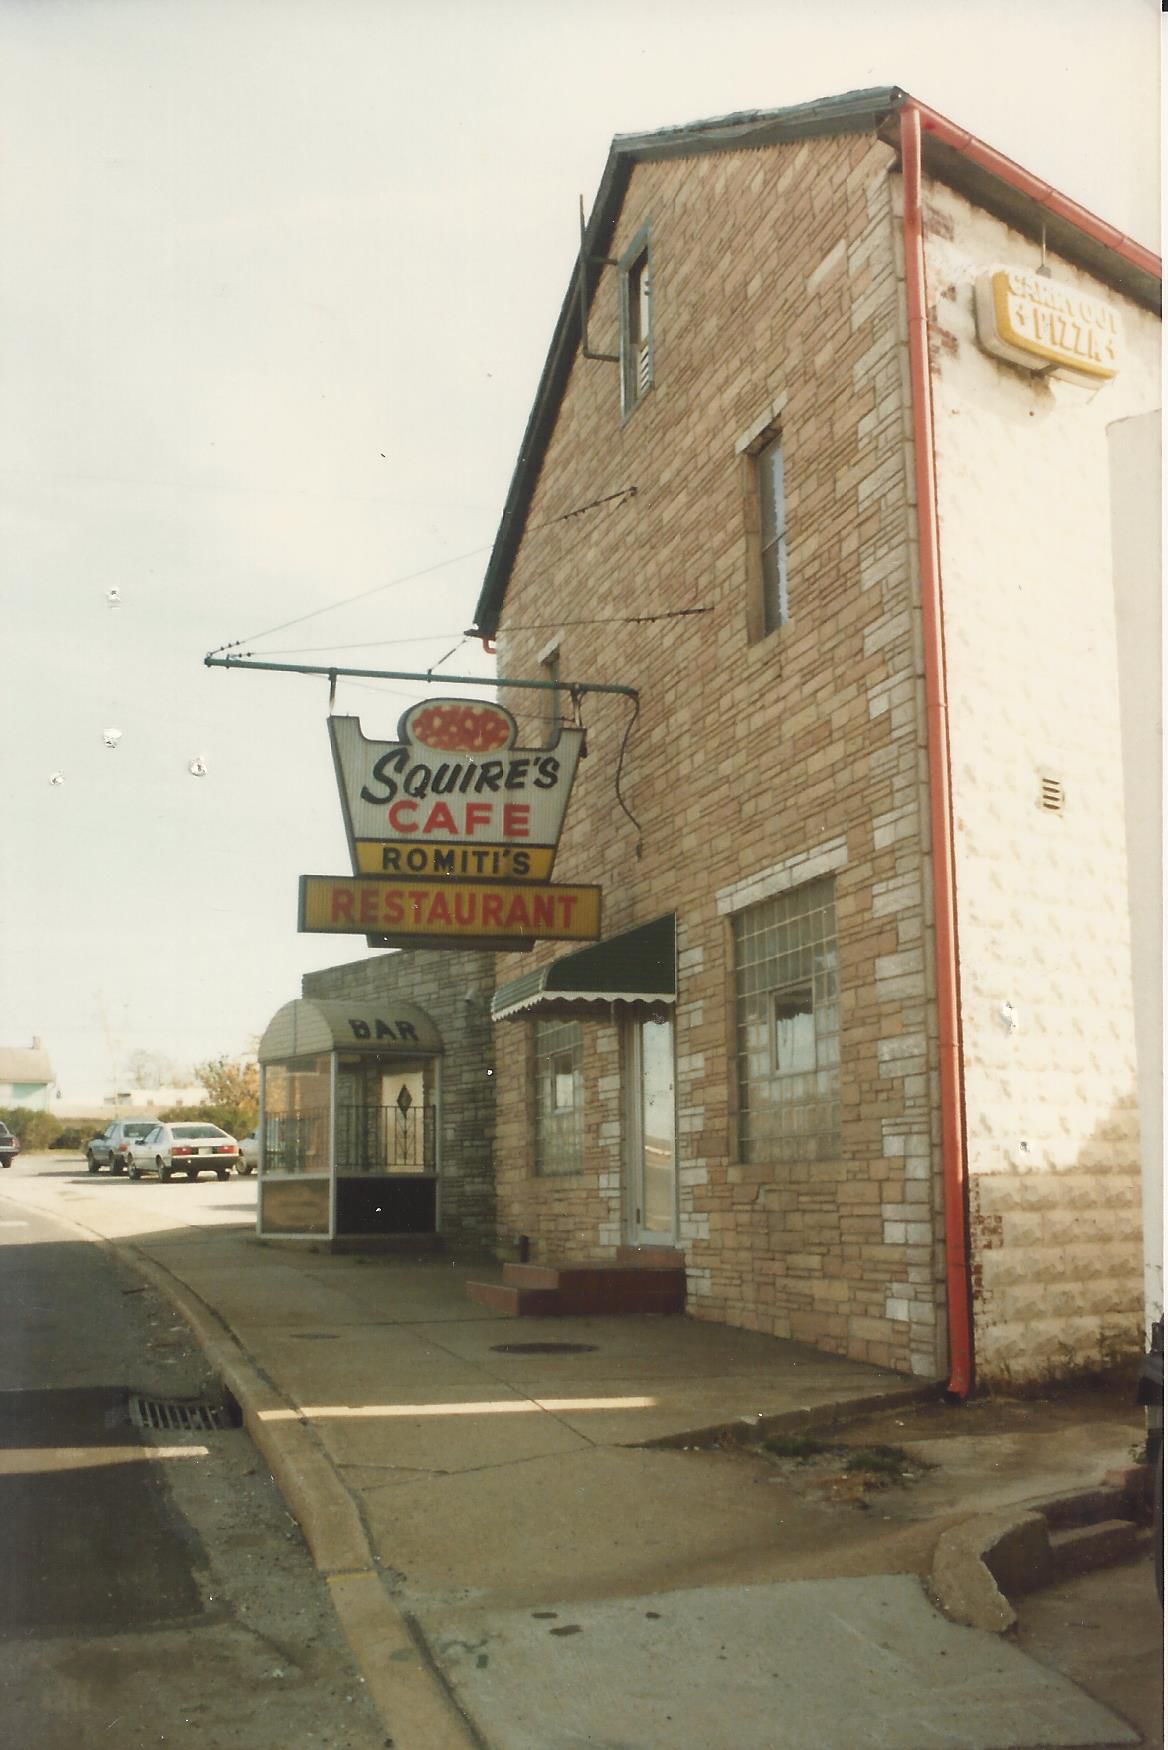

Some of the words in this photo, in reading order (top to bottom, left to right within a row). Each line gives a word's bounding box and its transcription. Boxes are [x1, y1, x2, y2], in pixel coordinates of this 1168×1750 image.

[360, 747, 561, 804] SQUIRE'S
[388, 800, 531, 837] CAFE
[382, 847, 531, 875] ROMITI'S
[330, 887, 578, 929] RESTAURANT
[348, 1018, 419, 1042] BAR
